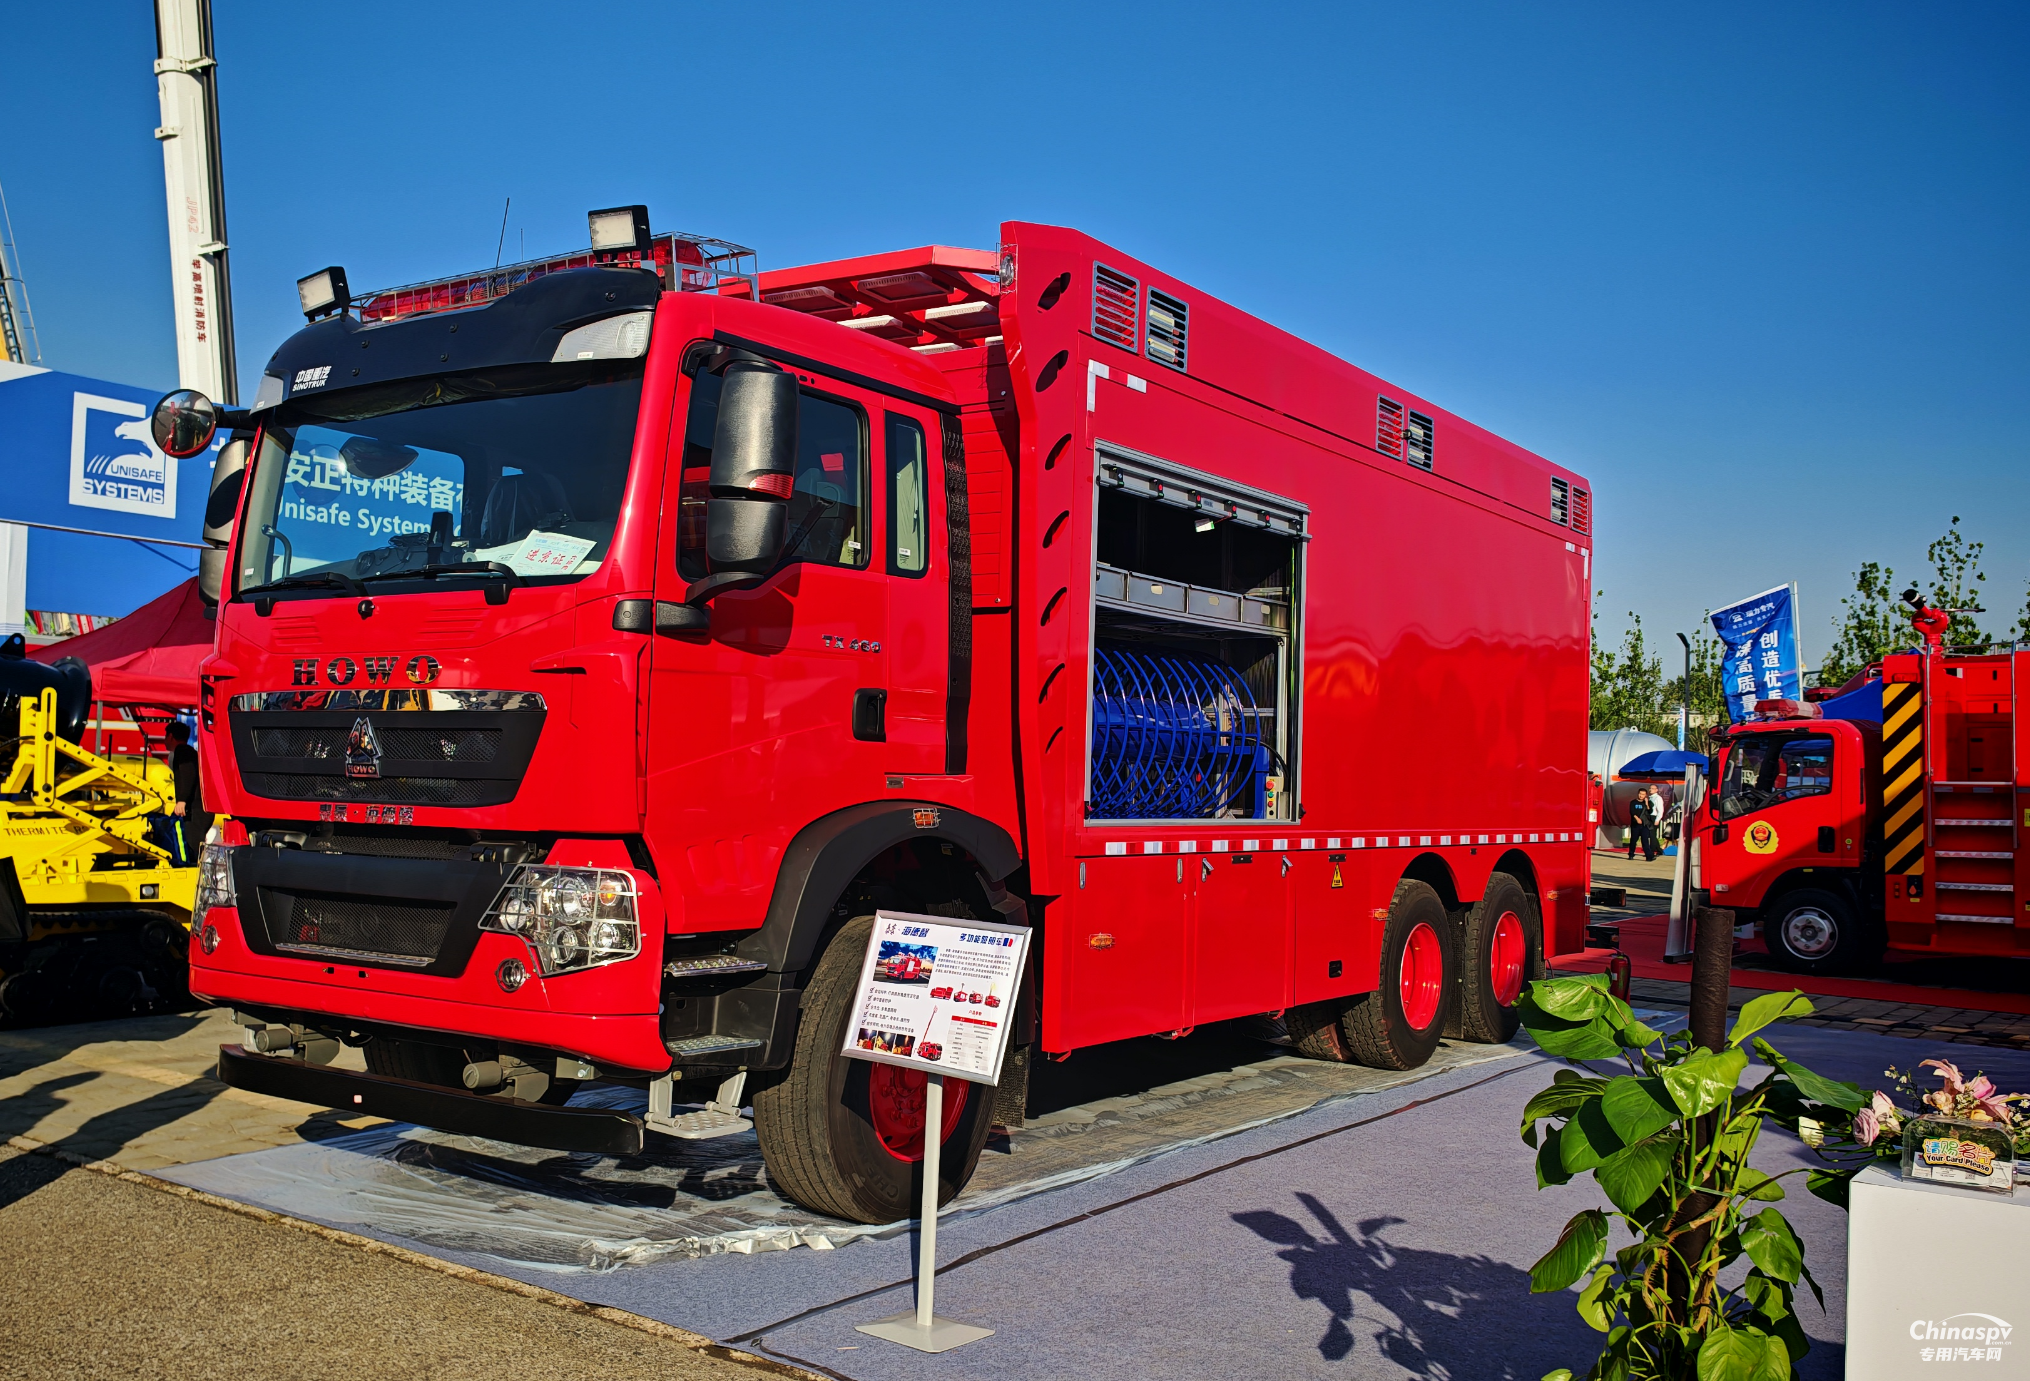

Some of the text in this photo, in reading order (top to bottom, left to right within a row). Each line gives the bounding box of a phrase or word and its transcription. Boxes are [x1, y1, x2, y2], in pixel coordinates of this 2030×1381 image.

[294, 366, 332, 383] 中国重汽
[292, 379, 327, 392] SINOTRUK
[110, 463, 163, 482] UNISAFE
[82, 478, 164, 505] SYSTEMS
[357, 508, 431, 537] System
[821, 634, 845, 649] TX
[291, 654, 441, 686] HOWO
[348, 765, 376, 774] HOWO
[4, 826, 68, 837] THERMITE
[1925, 1140, 1993, 1165] 请赐名片
[1926, 1155, 1944, 1163] Your
[1946, 1155, 1964, 1164] Card
[1965, 1158, 1990, 1172] Please
